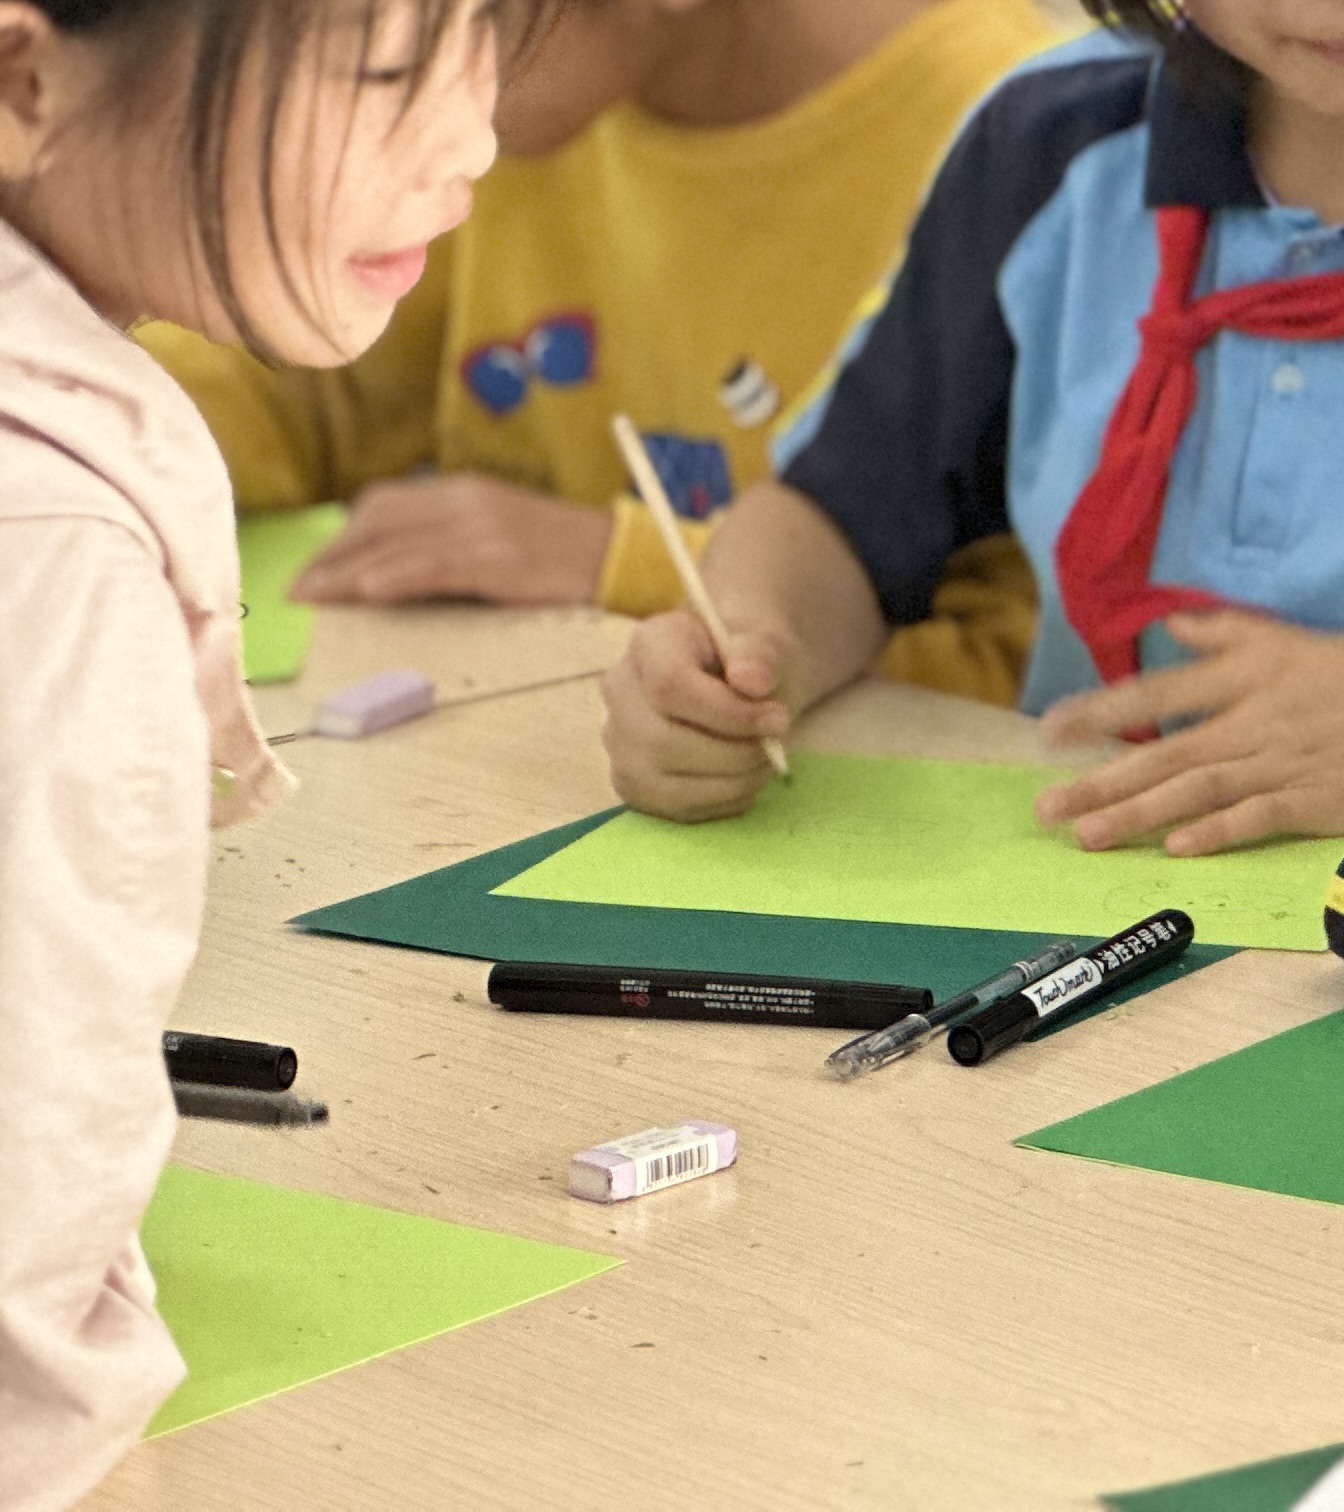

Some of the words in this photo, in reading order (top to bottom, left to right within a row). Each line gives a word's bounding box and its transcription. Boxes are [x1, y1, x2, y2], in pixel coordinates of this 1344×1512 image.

[1098, 921, 1171, 971] 油性记号笔
